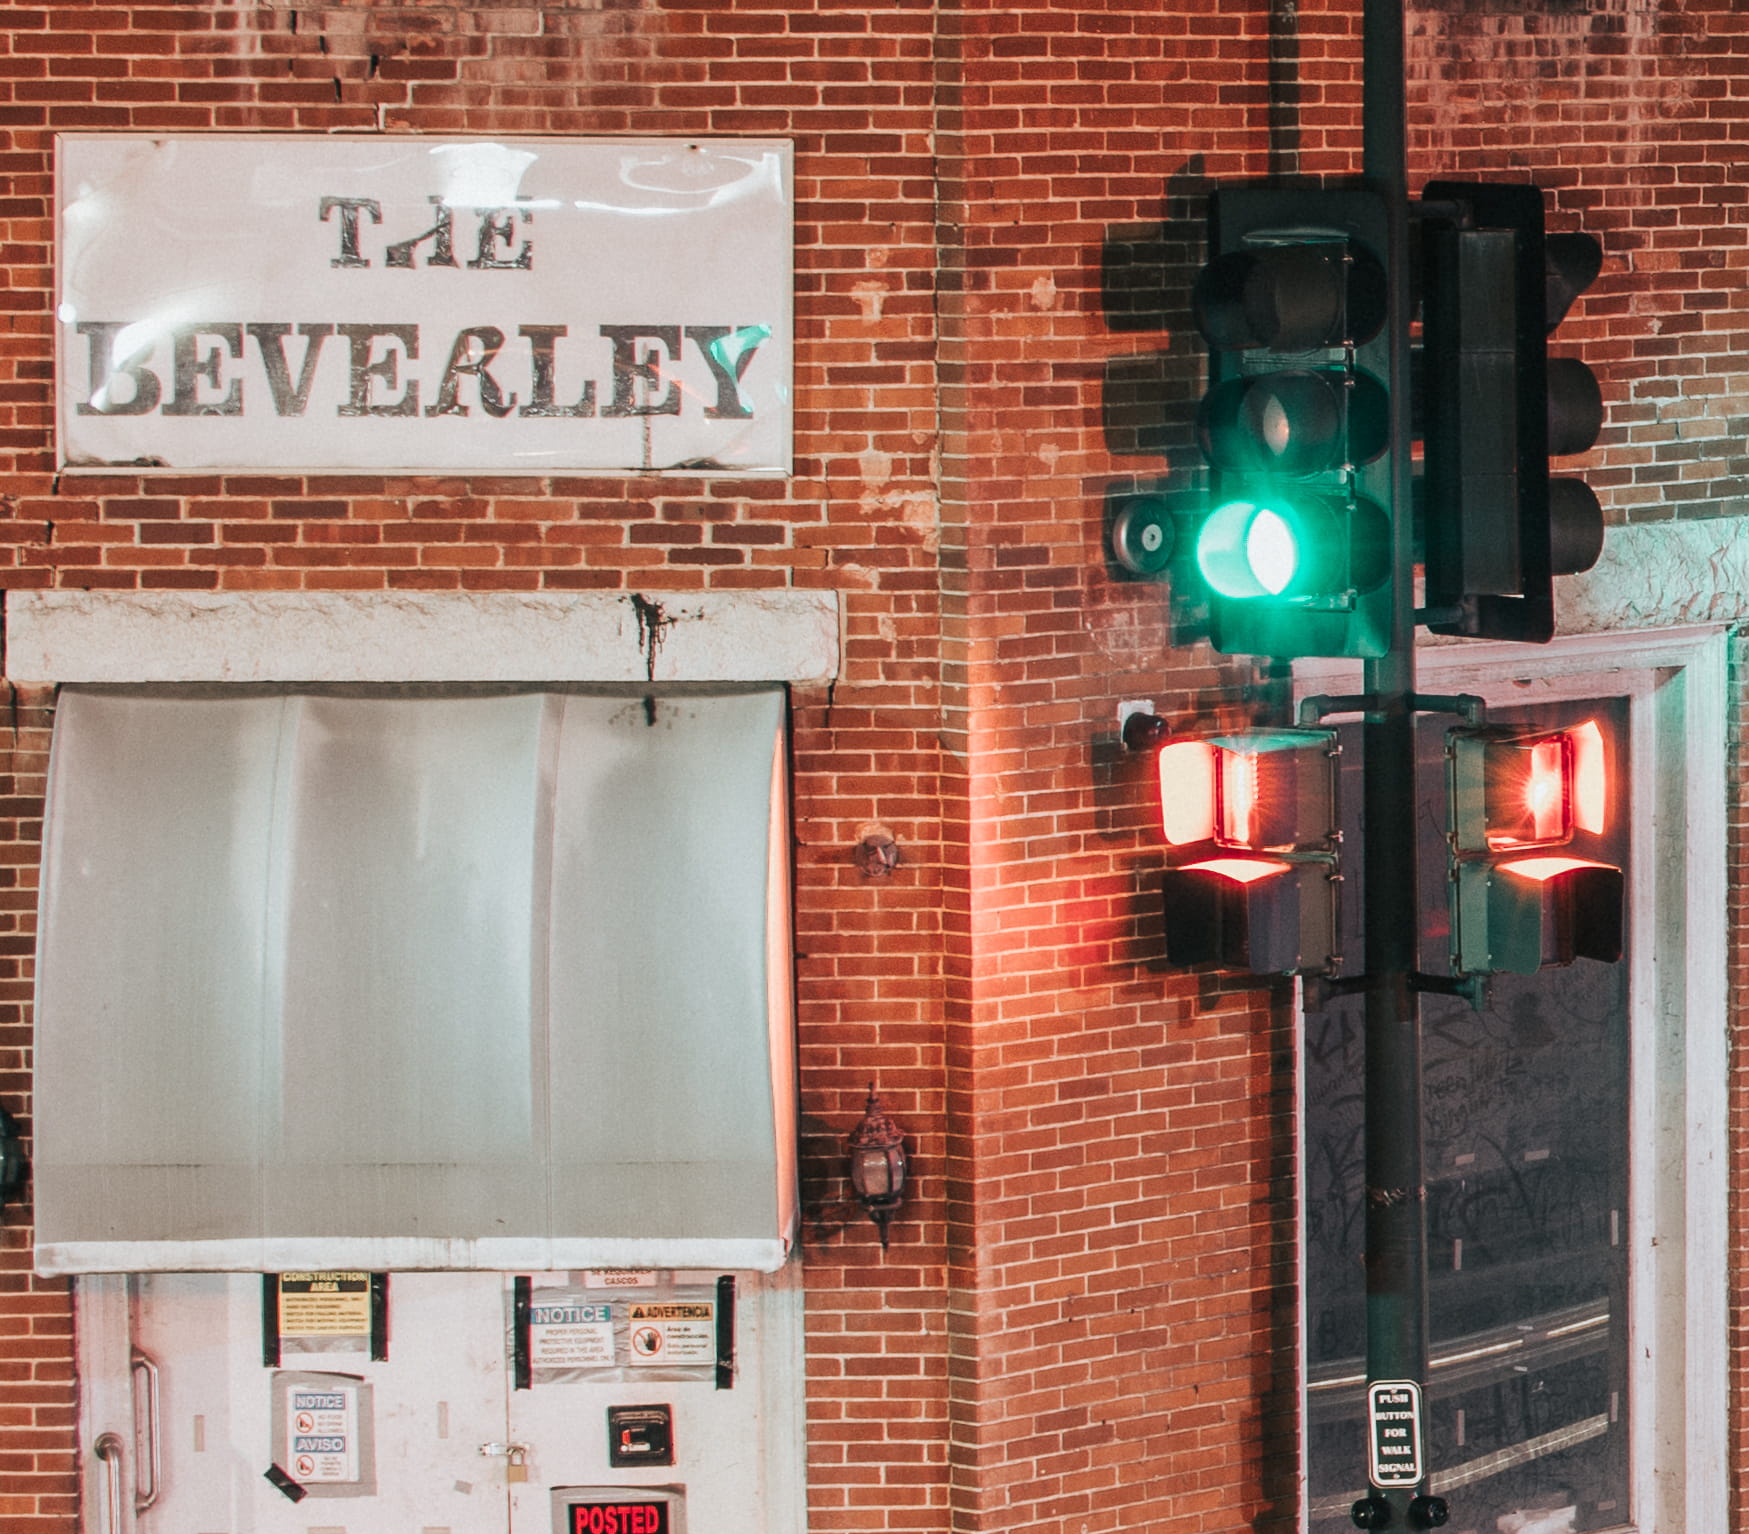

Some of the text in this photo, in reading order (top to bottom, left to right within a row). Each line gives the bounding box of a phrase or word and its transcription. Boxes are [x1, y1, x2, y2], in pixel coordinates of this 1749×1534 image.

[76, 322, 772, 420] BEVERLEY
[283, 1272, 368, 1282] CONSTRUCTION
[310, 1281, 340, 1292] AREA
[534, 1306, 608, 1323] NOTICE
[647, 1306, 710, 1318] ADVERTENCIA
[296, 1394, 344, 1408] NOTICE
[1378, 1394, 1409, 1404] PUSH
[1375, 1411, 1414, 1421] BUTTON
[1384, 1427, 1408, 1438] FOR
[296, 1438, 344, 1451] AVISO
[1381, 1445, 1412, 1456] WALK
[1378, 1463, 1416, 1473] SIGNAL
